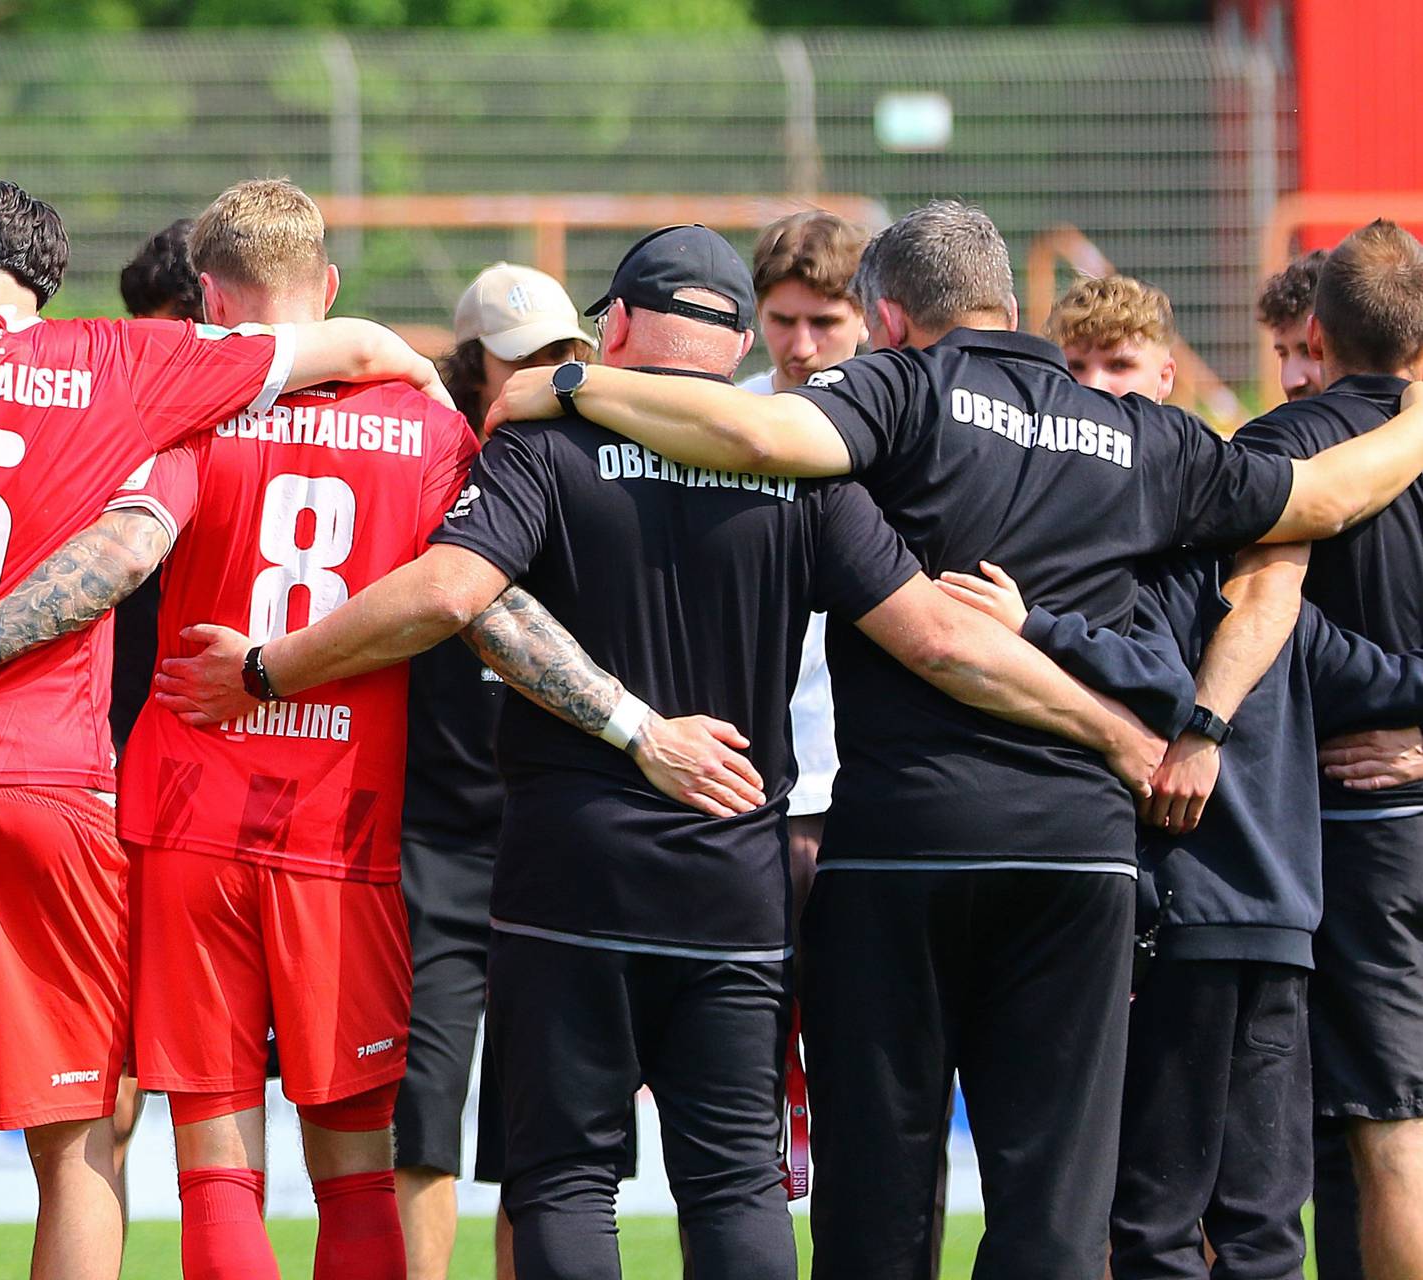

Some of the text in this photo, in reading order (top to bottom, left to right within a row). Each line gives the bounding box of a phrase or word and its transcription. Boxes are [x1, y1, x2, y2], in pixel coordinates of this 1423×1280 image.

[951, 388, 1133, 469] OBERHAUSEN
[249, 473, 356, 646] 8
[366, 1038, 394, 1055] PATRICK
[60, 1070, 99, 1085] PATRICK
